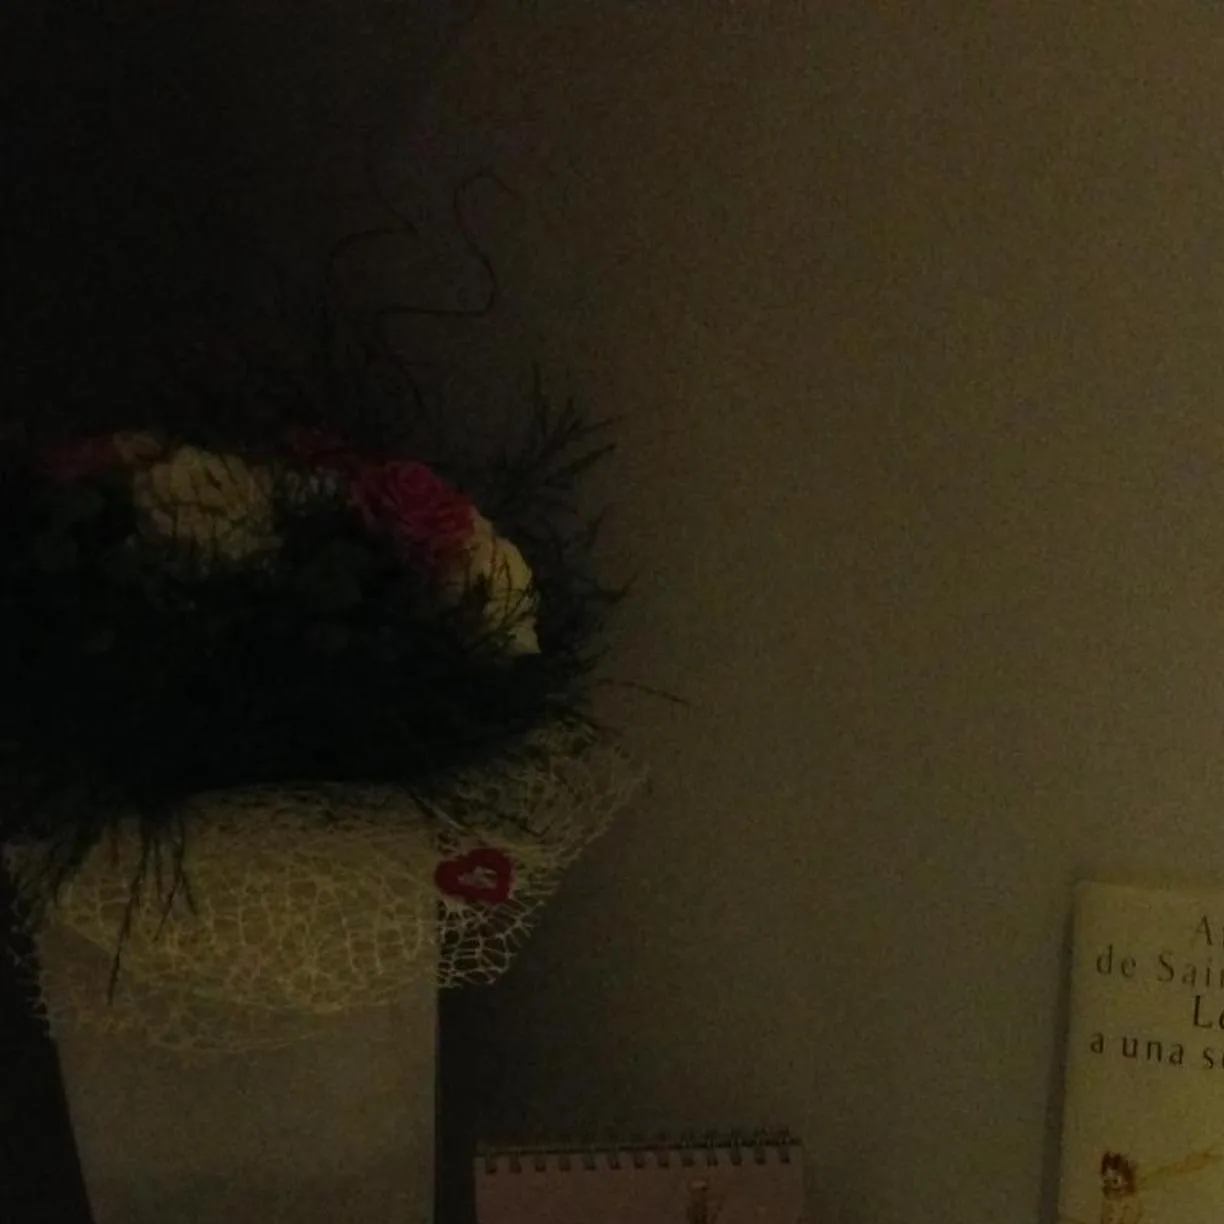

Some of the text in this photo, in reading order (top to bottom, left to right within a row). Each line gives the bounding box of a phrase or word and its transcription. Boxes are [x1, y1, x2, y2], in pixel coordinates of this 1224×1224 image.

[1095, 943, 1138, 979] de
[1090, 1032, 1105, 1055] a
[1120, 1034, 1185, 1067] una
